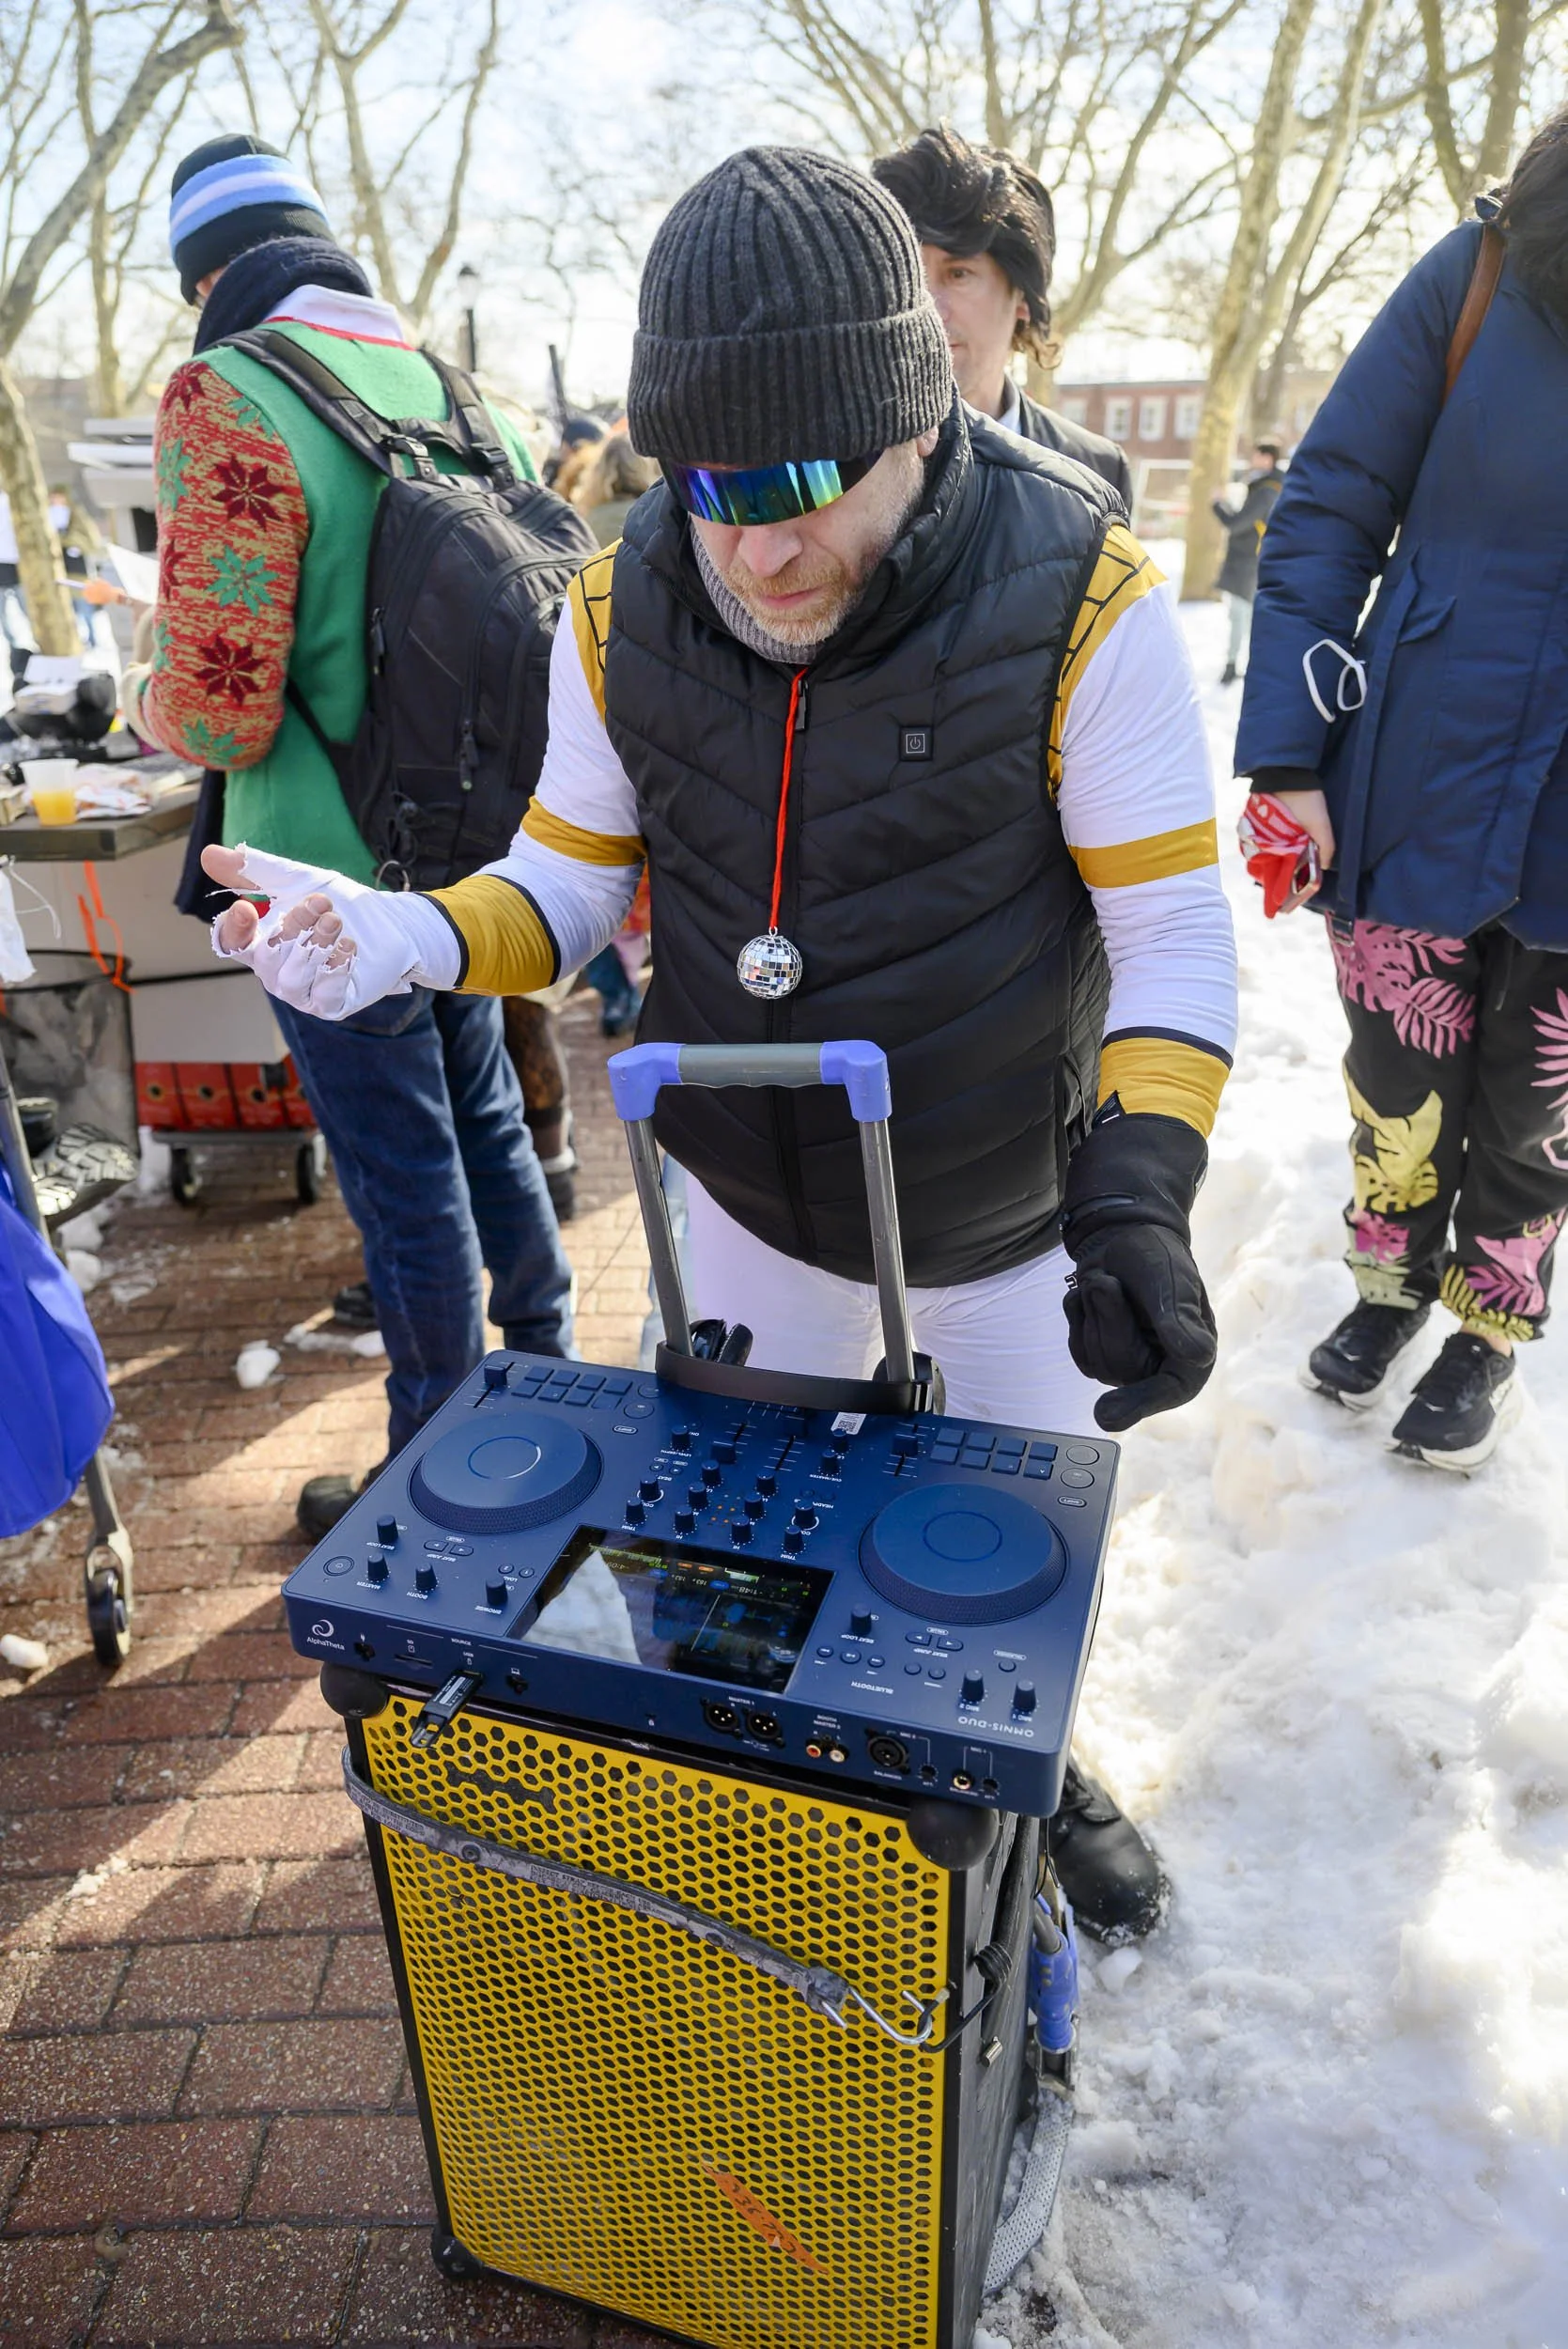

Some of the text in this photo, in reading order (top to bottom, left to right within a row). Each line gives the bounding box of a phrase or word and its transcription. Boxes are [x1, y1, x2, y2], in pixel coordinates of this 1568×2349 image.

[356, 1581, 381, 1590] MASTER
[406, 1591, 428, 1600] BOOTH
[474, 1605, 503, 1615] BROWSE
[306, 1635, 346, 1651] AlphaTheta
[451, 1637, 473, 1646] SOURCE
[841, 1633, 875, 1644] BEAT LOOP
[912, 1647, 948, 1658] BEAT JUMP
[850, 1680, 893, 1695] BLUETOOTH
[957, 1716, 1034, 1737] OMNIS-DUO
